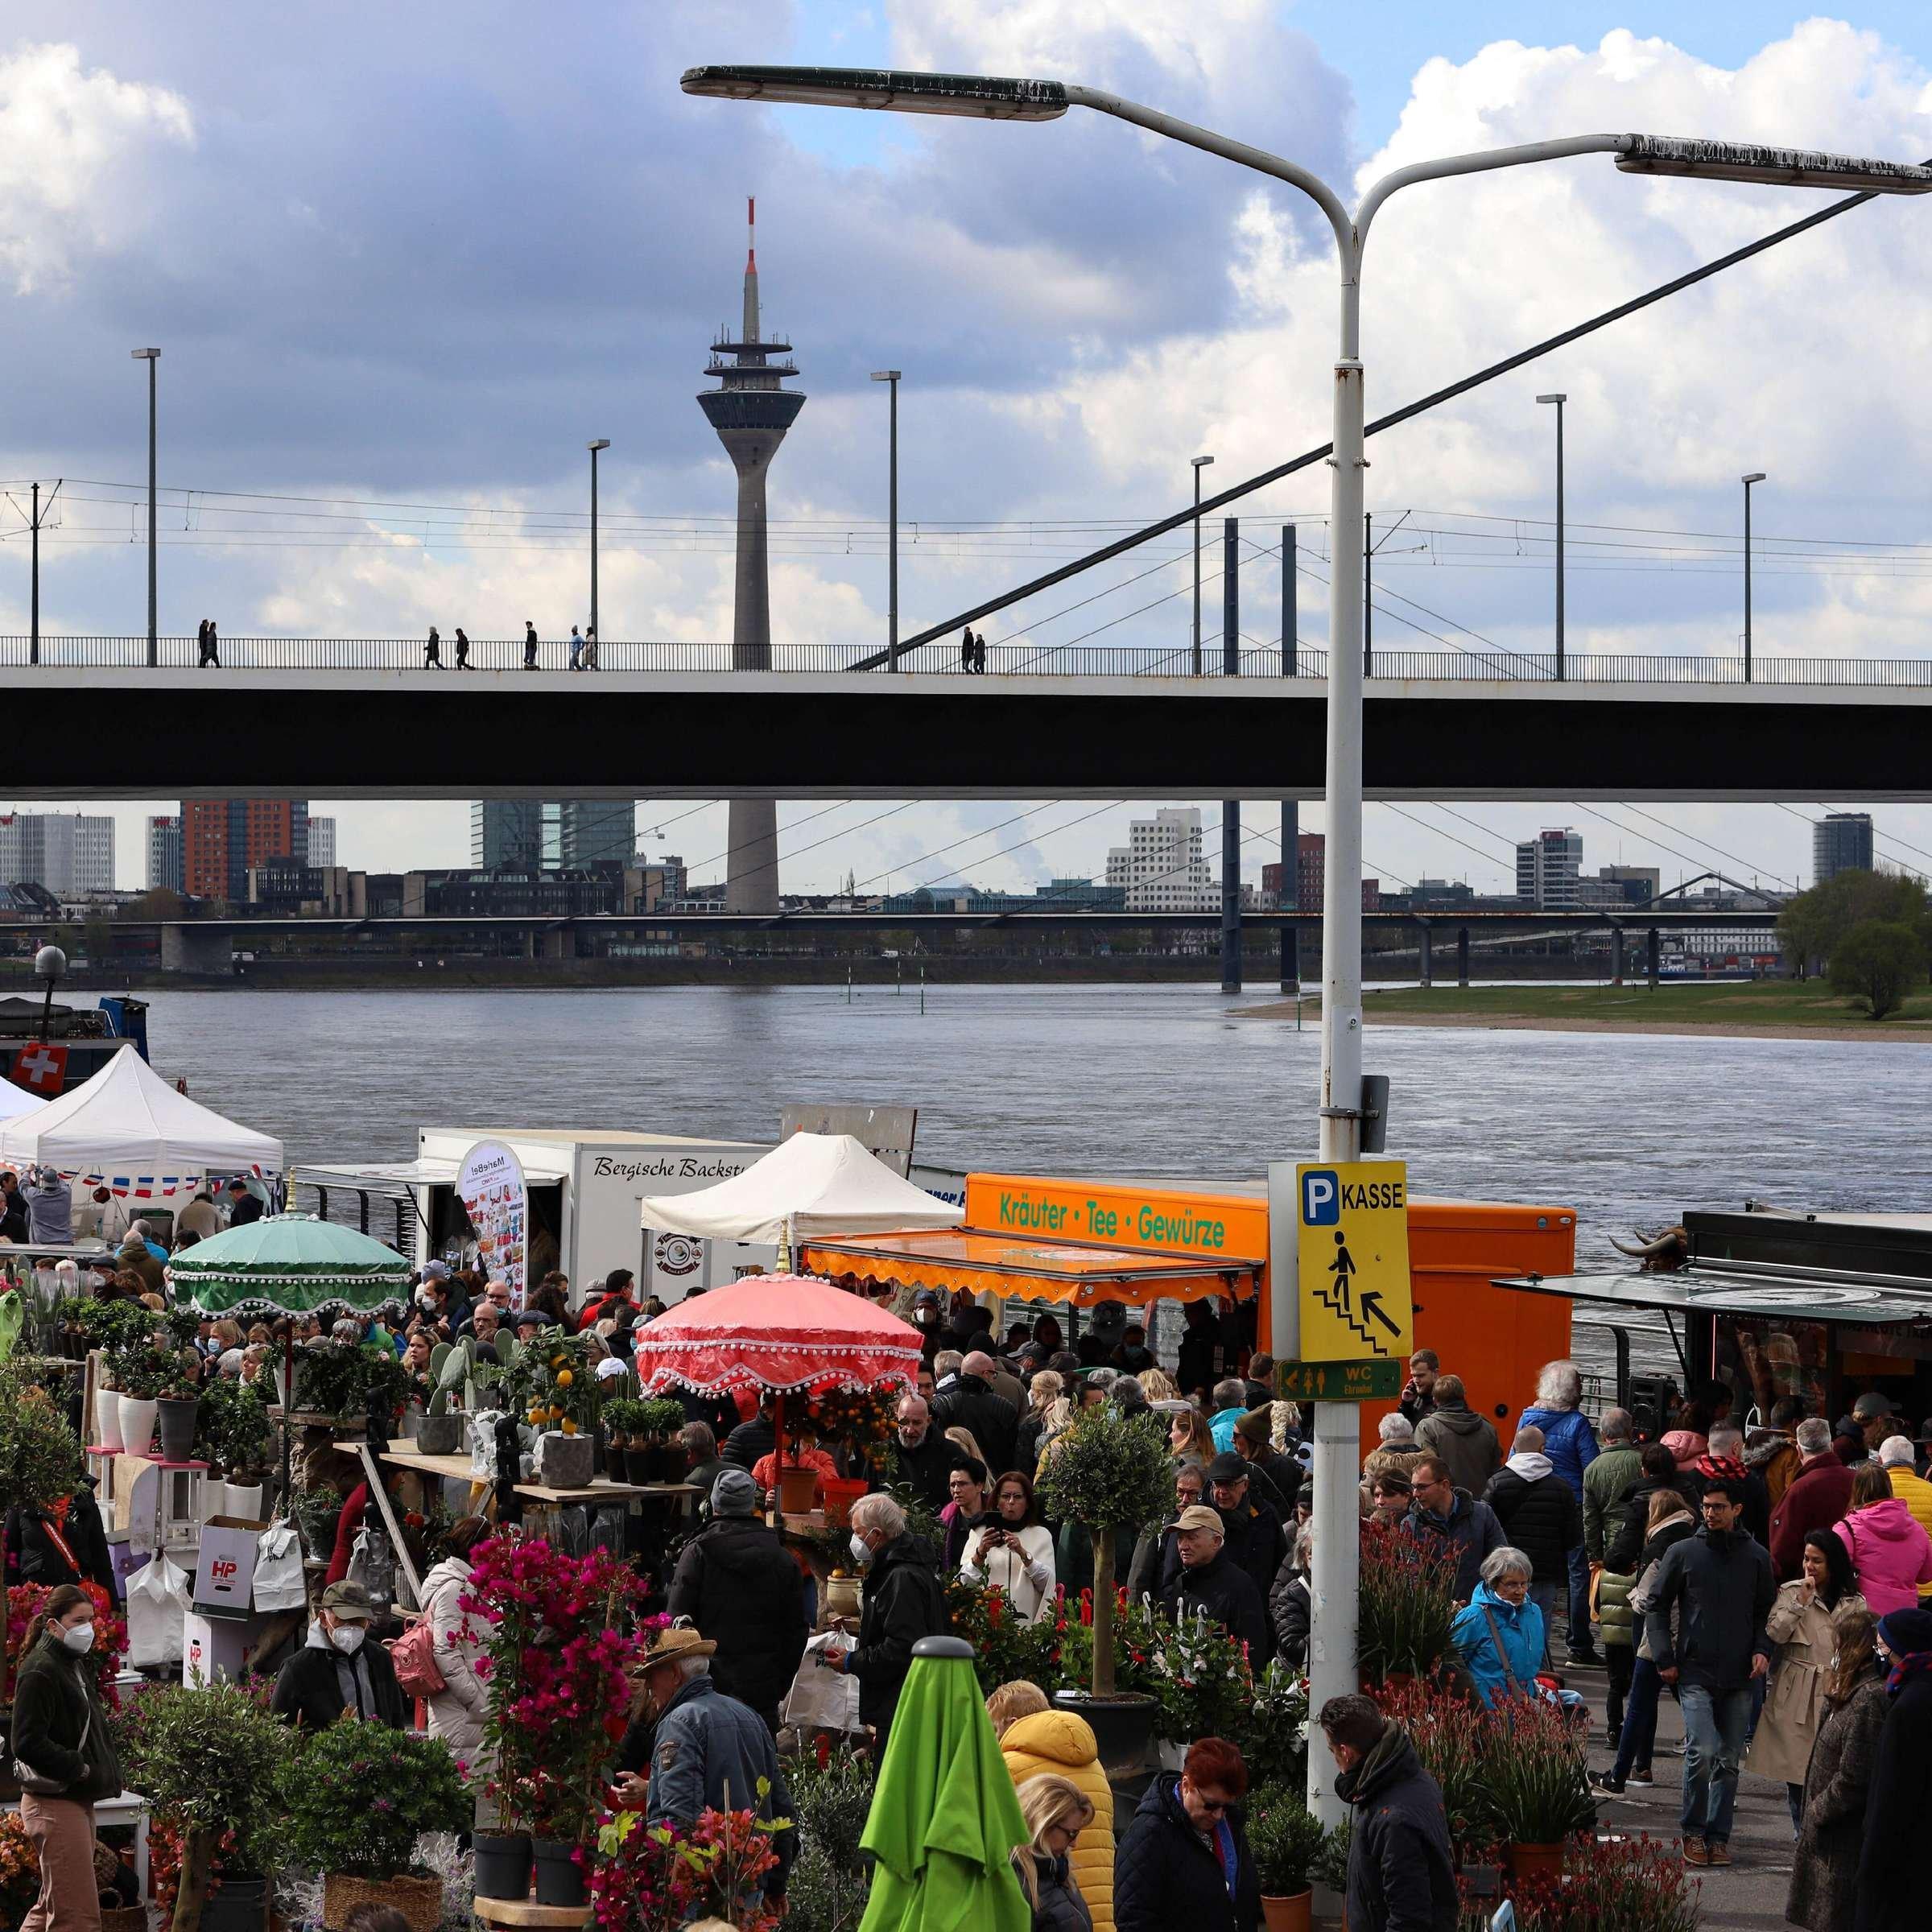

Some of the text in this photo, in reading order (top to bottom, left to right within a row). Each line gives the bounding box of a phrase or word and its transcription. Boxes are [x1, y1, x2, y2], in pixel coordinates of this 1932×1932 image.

[594, 1157, 674, 1181] Bergische
[1308, 1179, 1403, 1218] P KASSE
[1000, 1191, 1067, 1230] Kräuter
[1087, 1200, 1117, 1236] Tee
[1138, 1205, 1224, 1248] Gewürze
[1346, 1366, 1372, 1381] WC
[212, 1561, 237, 1578] HP
[190, 1646, 201, 1662] HP
